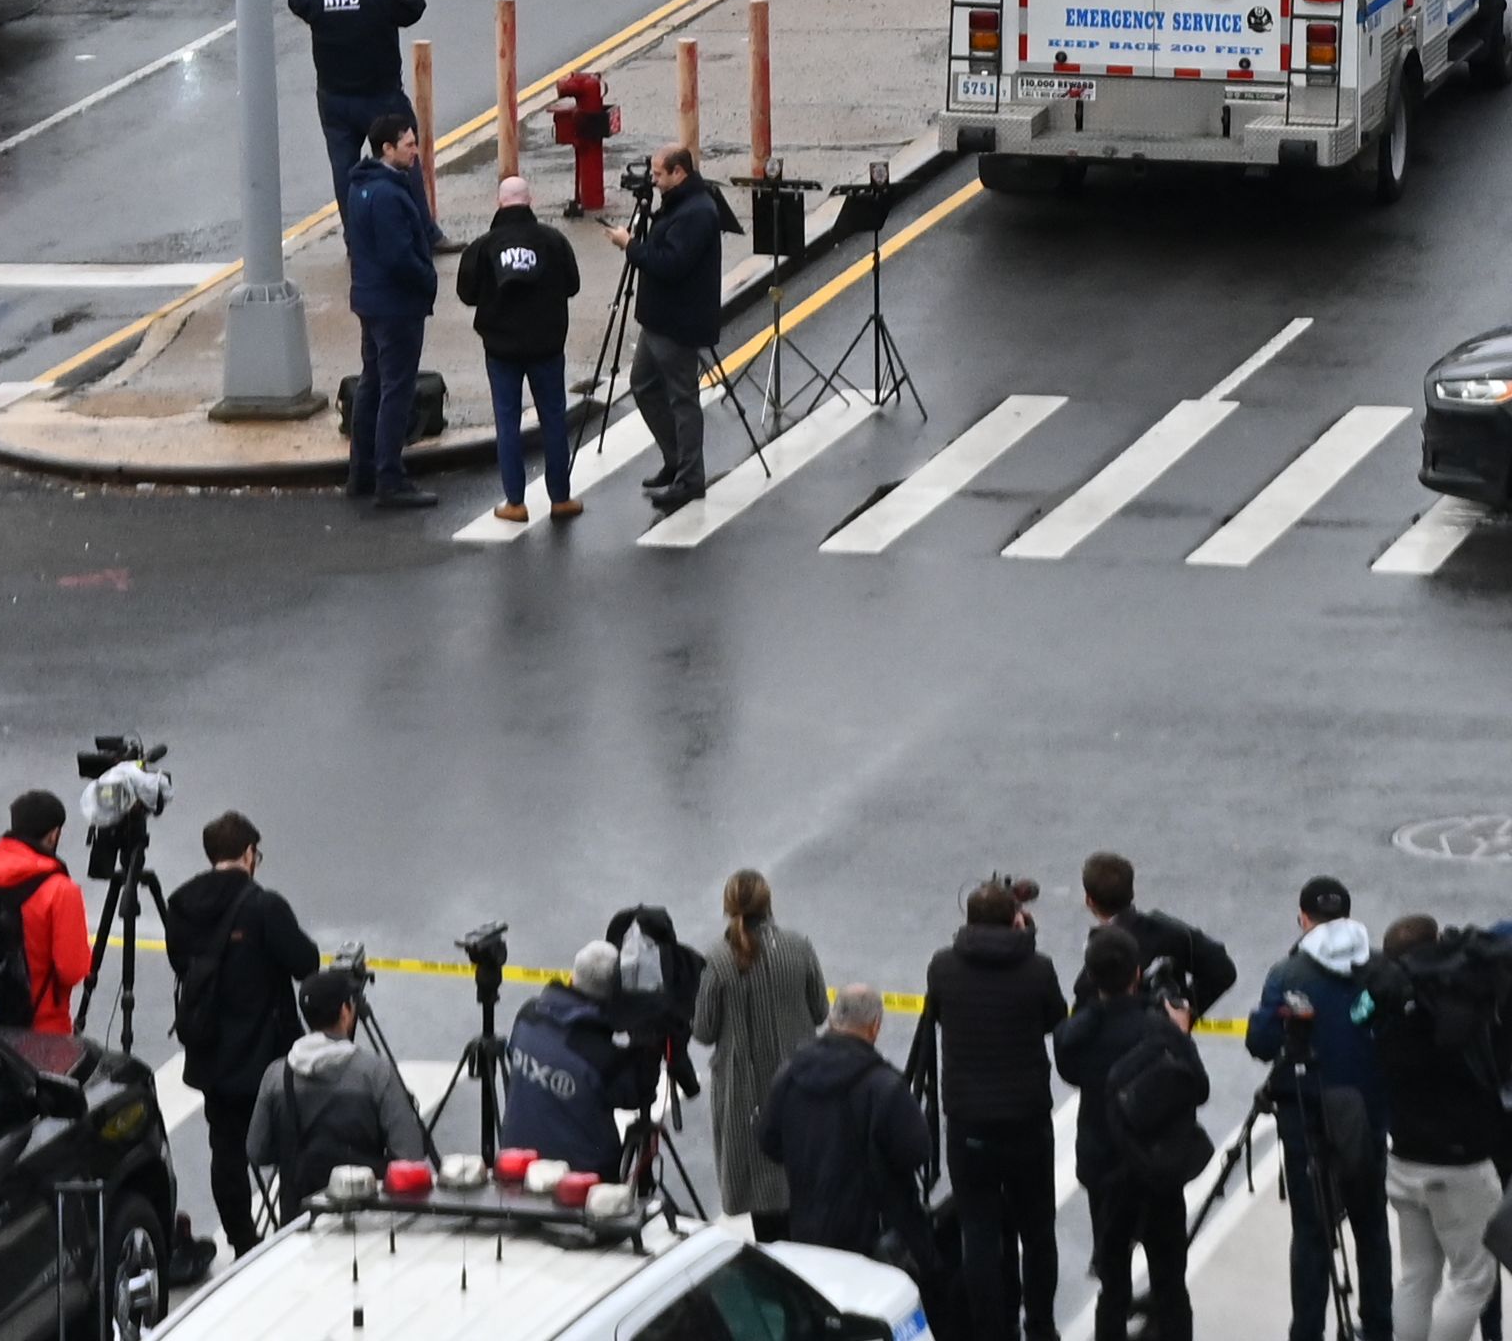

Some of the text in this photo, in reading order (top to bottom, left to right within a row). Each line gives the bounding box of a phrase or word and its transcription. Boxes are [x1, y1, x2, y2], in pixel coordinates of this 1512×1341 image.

[1065, 8, 1243, 34] EMERGENCY SERVICE
[1047, 38, 1264, 56] KEEP BACK 200 FEET
[962, 80, 995, 97] 5751
